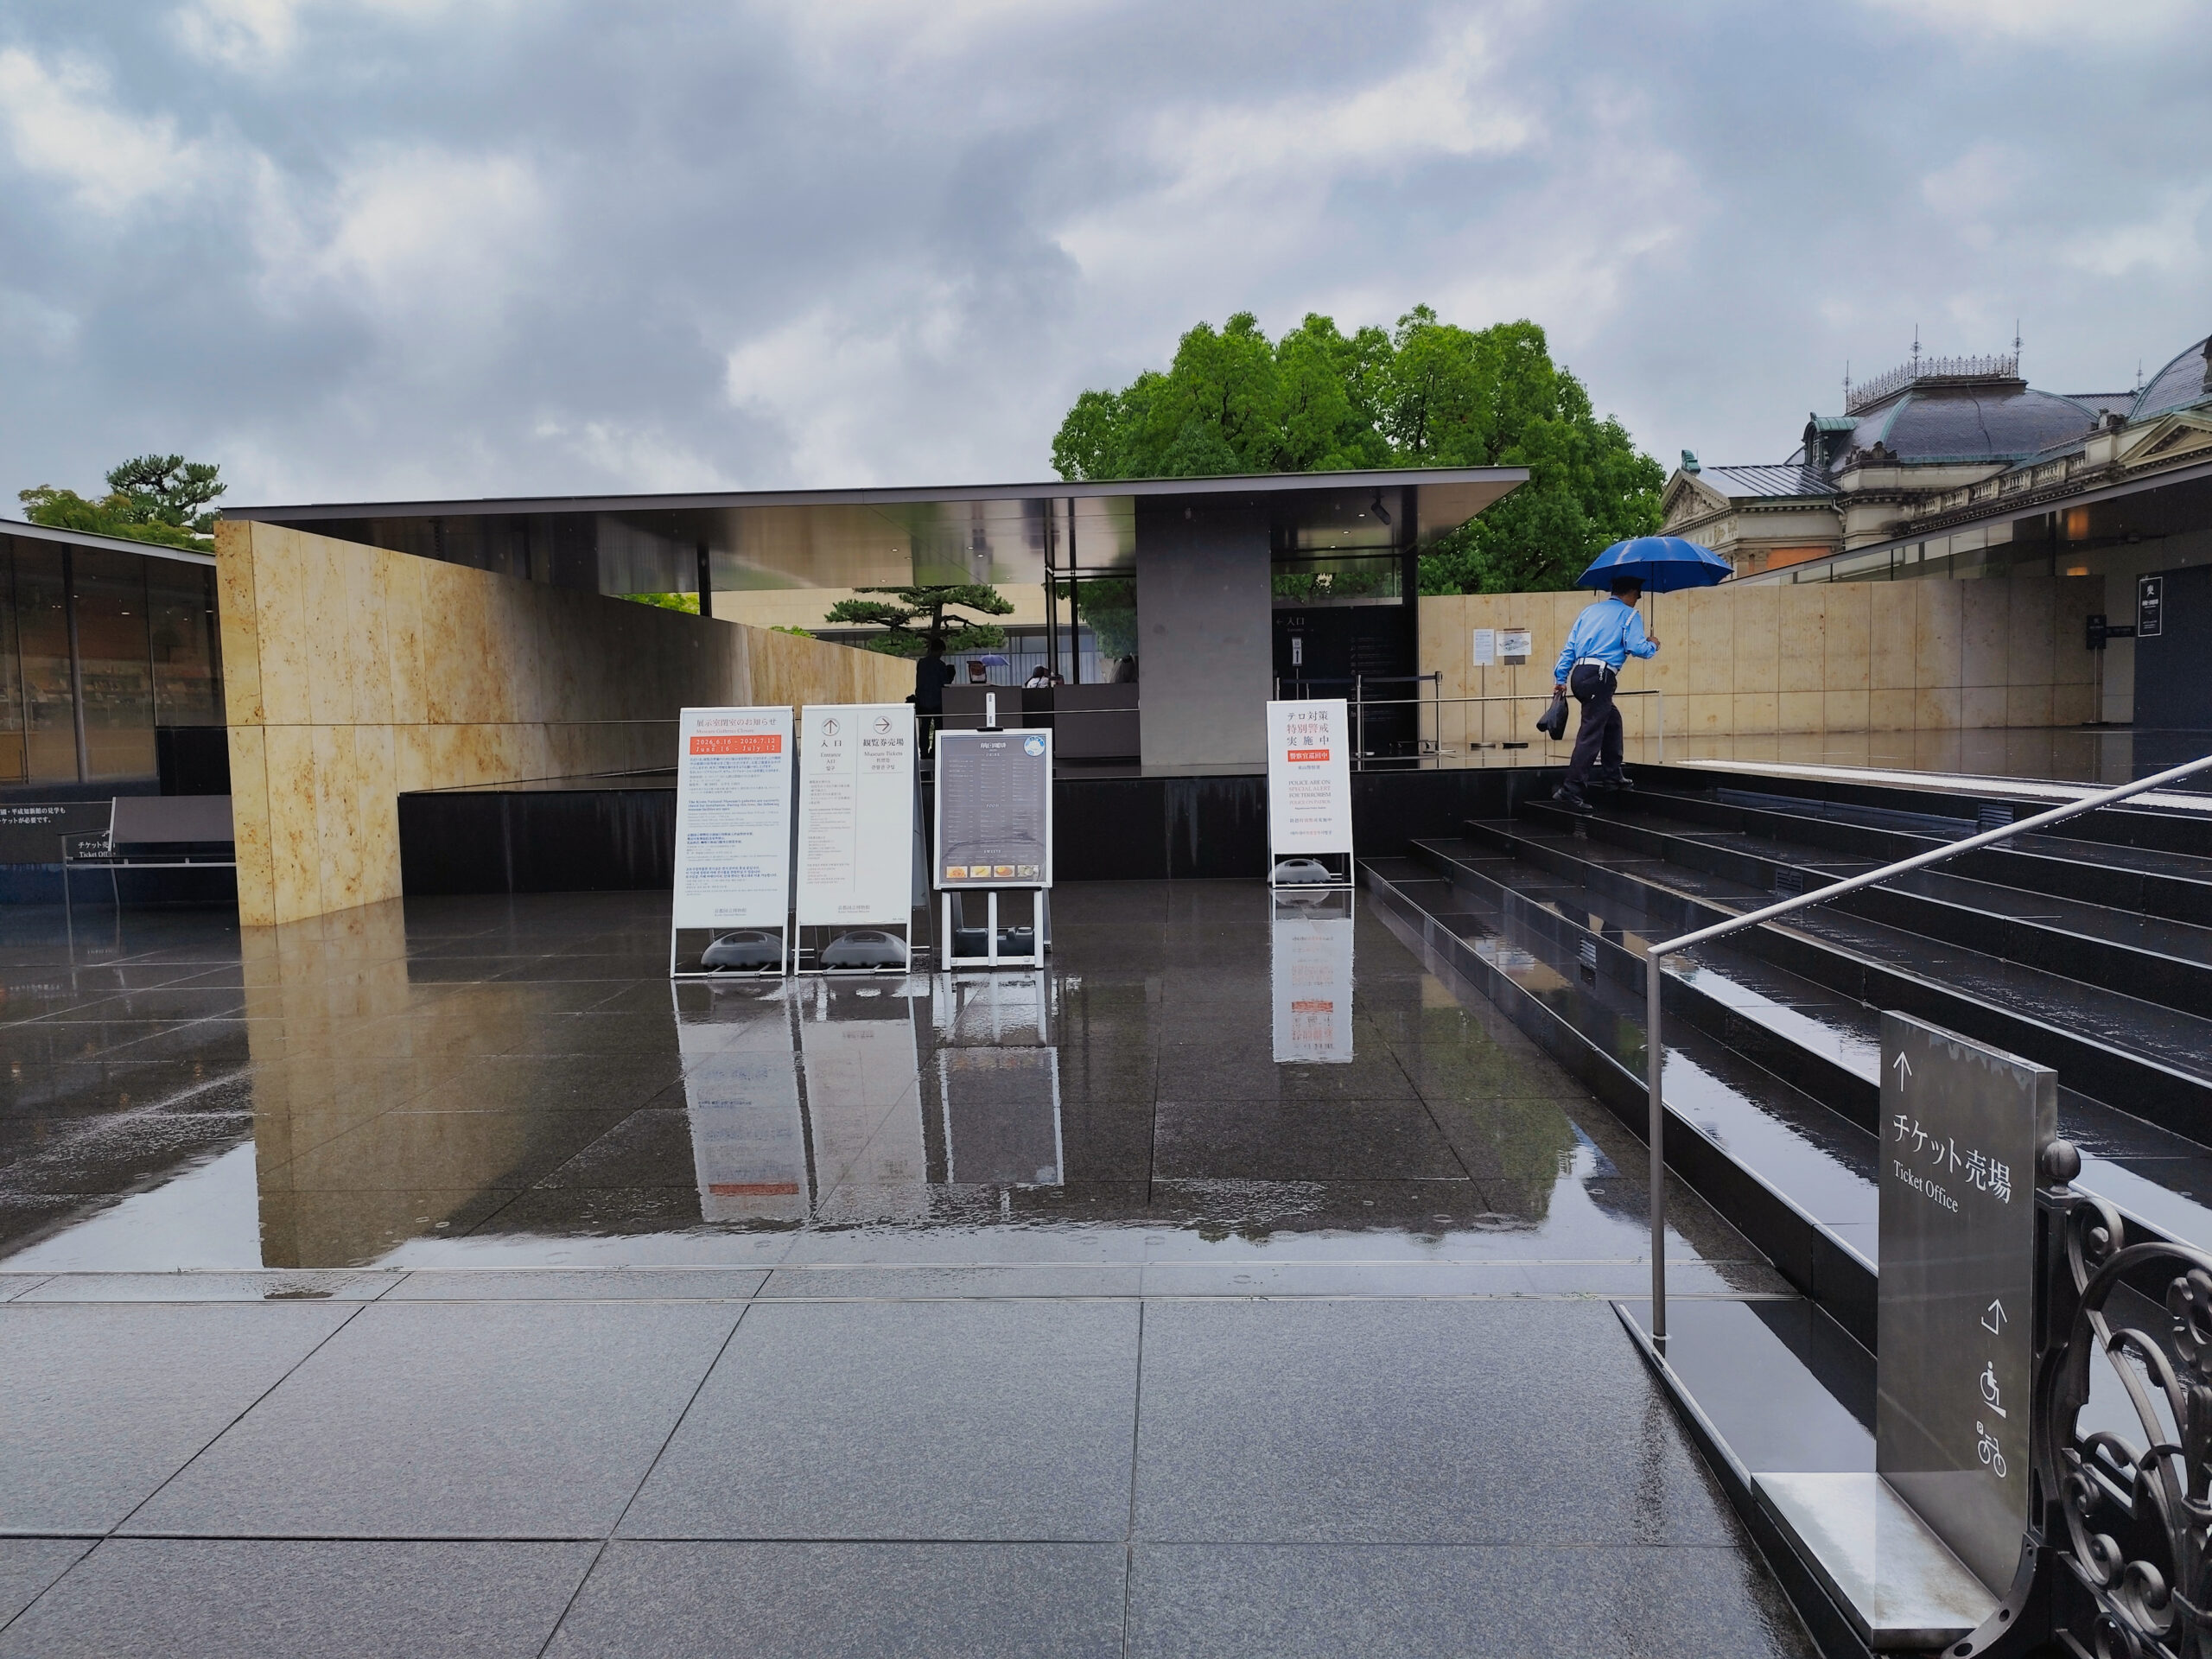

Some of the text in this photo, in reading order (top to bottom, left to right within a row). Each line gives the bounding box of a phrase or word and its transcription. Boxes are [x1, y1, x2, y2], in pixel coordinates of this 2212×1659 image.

[1287, 710, 1328, 721] テロ対策
[1287, 723, 1329, 734] 特別警戒
[863, 738, 905, 747] 観覧券売場
[1287, 735, 1329, 746] 実施中
[1893, 1114, 2012, 1205] チケット売場
[1893, 1160, 1959, 1213] Ticket Office
